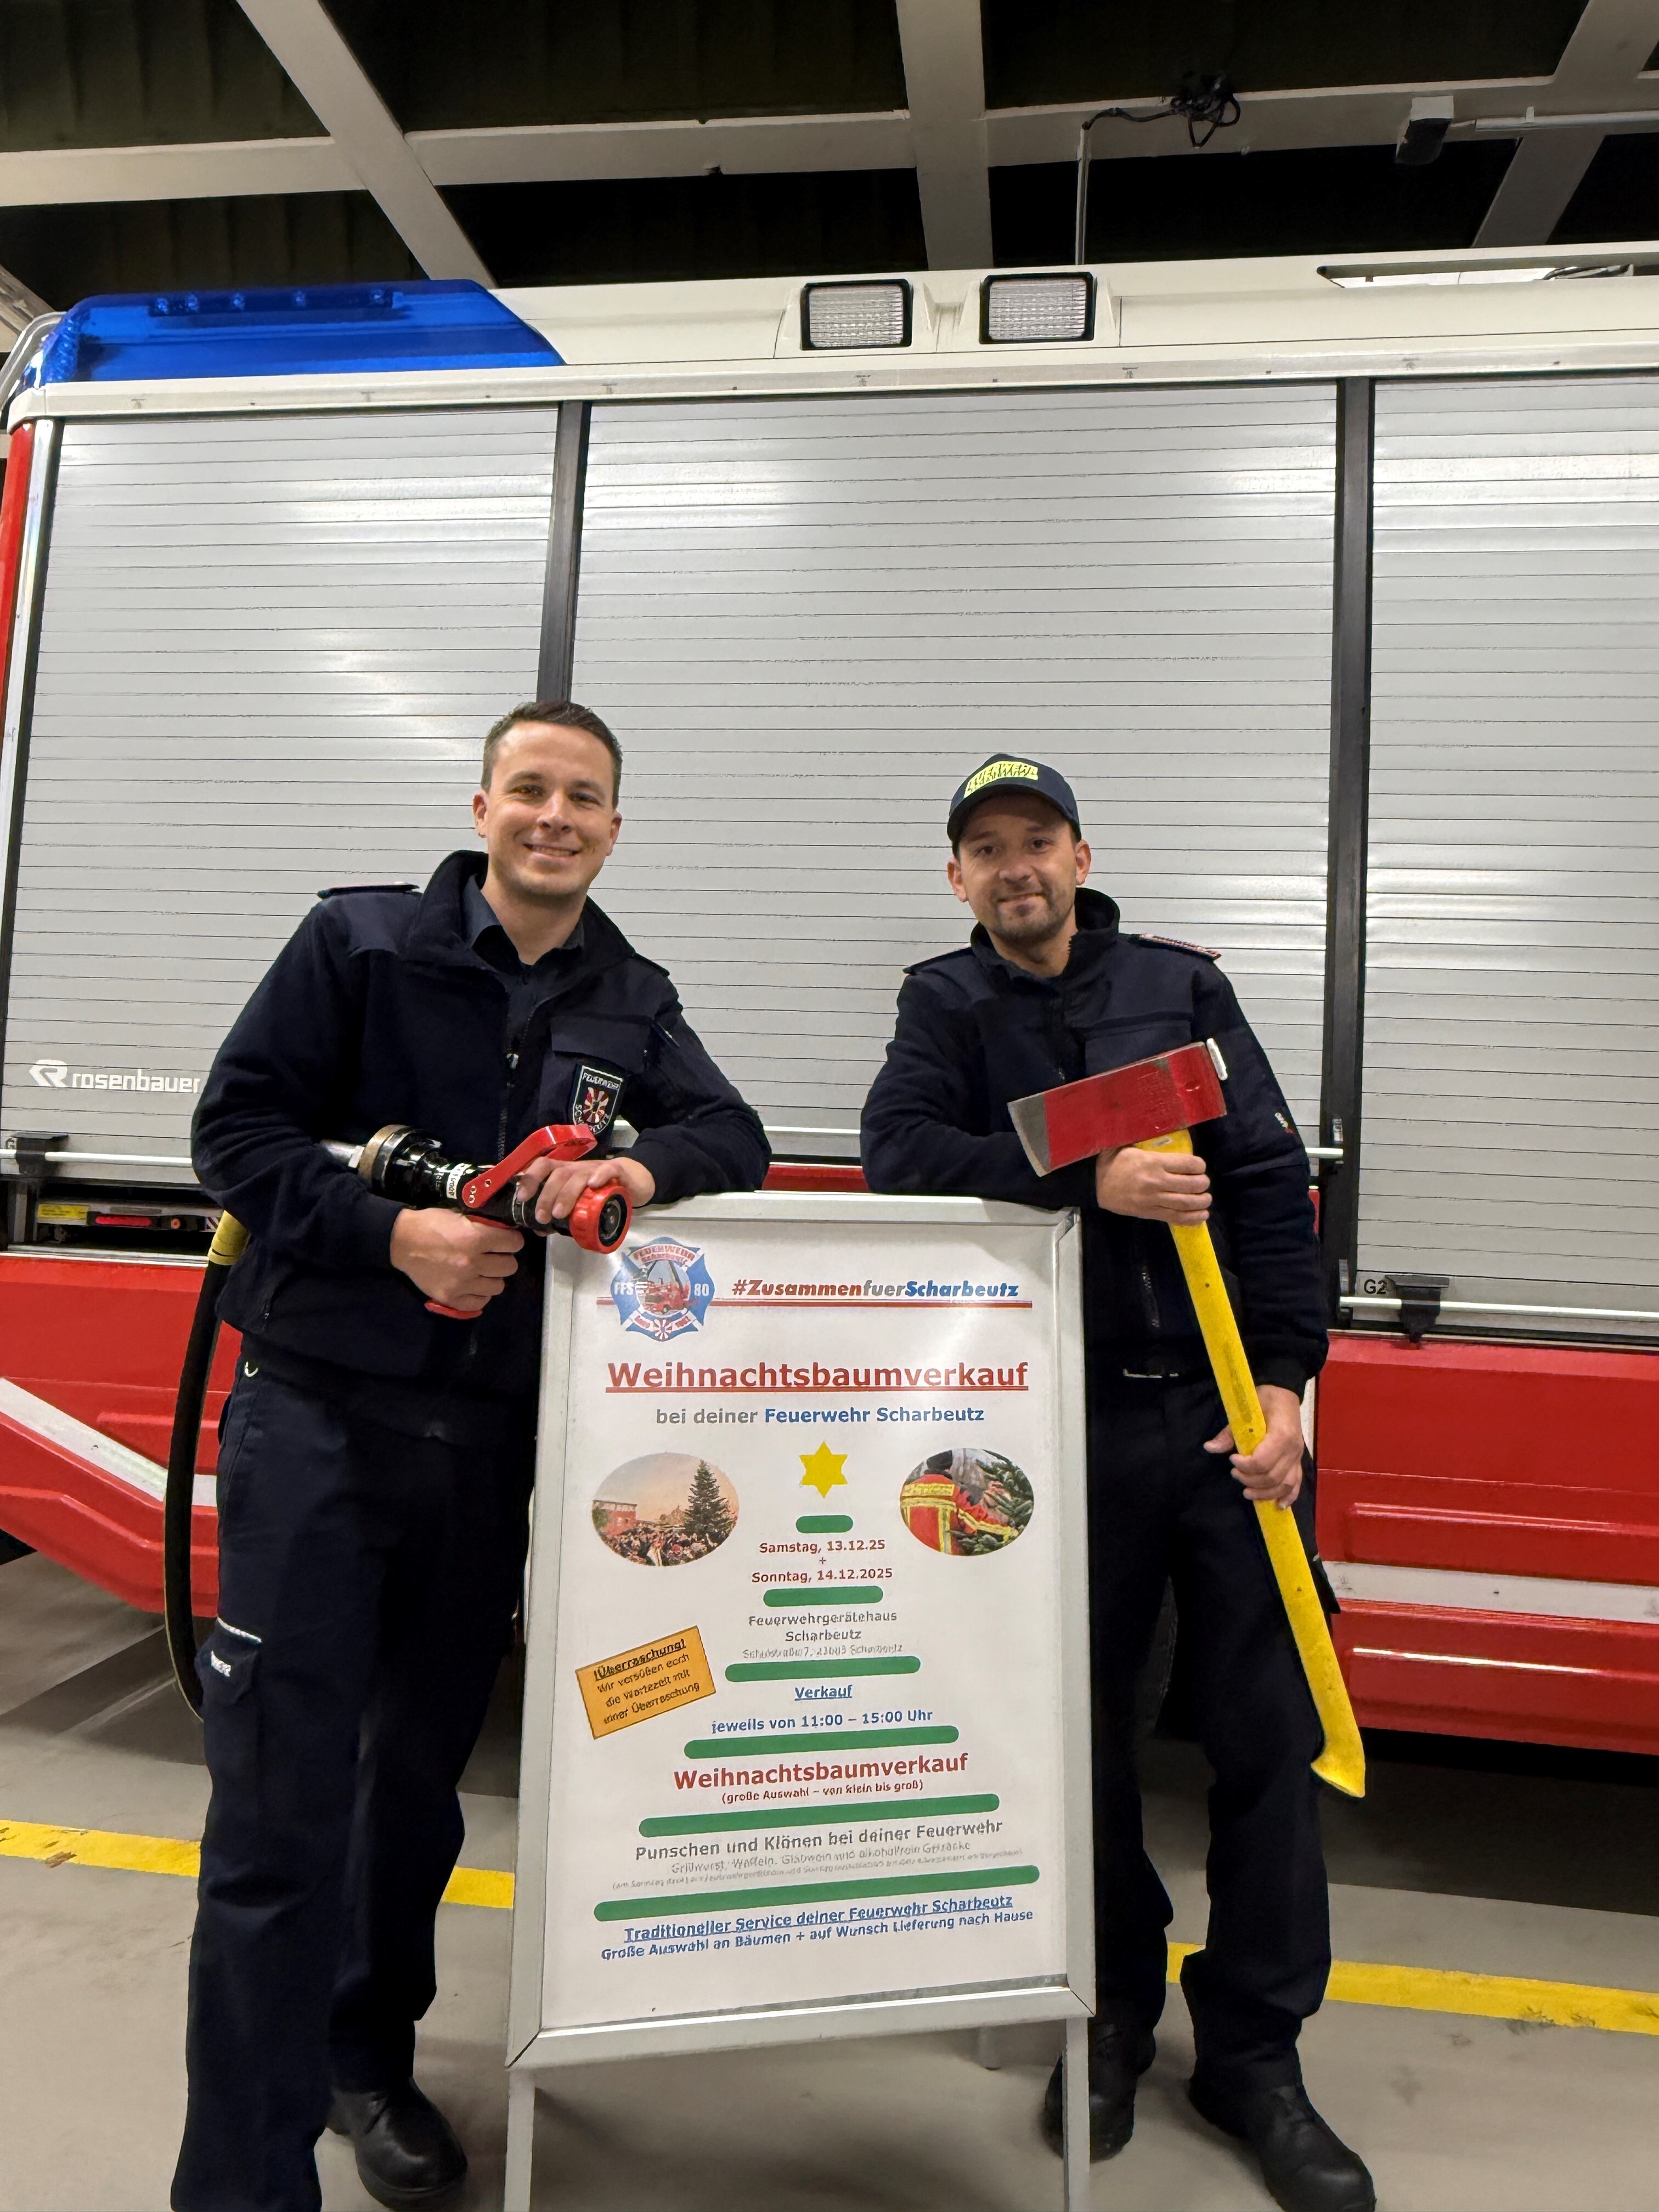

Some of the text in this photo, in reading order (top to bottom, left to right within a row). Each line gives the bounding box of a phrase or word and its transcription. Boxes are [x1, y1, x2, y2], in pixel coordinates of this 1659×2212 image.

[72, 1069, 201, 1093] rosenbauer
[614, 1282, 634, 1295] FFS
[694, 1283, 710, 1296] 80
[732, 1279, 1019, 1297] #ZusammenfuerScharbeutz
[1363, 1278, 1387, 1295] G2
[608, 1362, 1029, 1387] Weihnachtsbaumverkauf
[656, 1407, 985, 1424] bei deiner Feuerwehr Scharbeutz
[759, 1539, 885, 1554] Samstag, 13.12.25
[752, 1568, 893, 1583] Sonntag, 14.12.2025
[749, 1611, 898, 1626] Feuerwehrgerätehaus
[786, 1629, 862, 1643] Scharbeutz
[597, 1681, 614, 1693] Wir
[606, 1695, 620, 1708] die
[674, 1669, 690, 1681] mit
[795, 1684, 853, 1699] Verkauf
[712, 1718, 765, 1734] jeweils
[770, 1717, 795, 1729] von
[802, 1714, 843, 1728] 11:00
[862, 1711, 902, 1724] 15:00
[908, 1709, 933, 1722] Uhr
[674, 1752, 969, 1790] Weihnachtsbaumverkauf
[721, 1791, 760, 1804] (große
[763, 1786, 809, 1800] Auswahl
[823, 1786, 843, 1796] von
[876, 1781, 891, 1792] bis
[894, 1779, 924, 1793] groß)
[636, 1819, 1003, 1861] Punschen und Klönen bei deiner Feuerwehr
[624, 1895, 1013, 1942] Traditioneller Service deiner Feuerwehr Scharbeutz
[601, 1910, 1033, 1961] Große Auswahl an Bäumen + auf Wunsch Lieferung nach Hause
